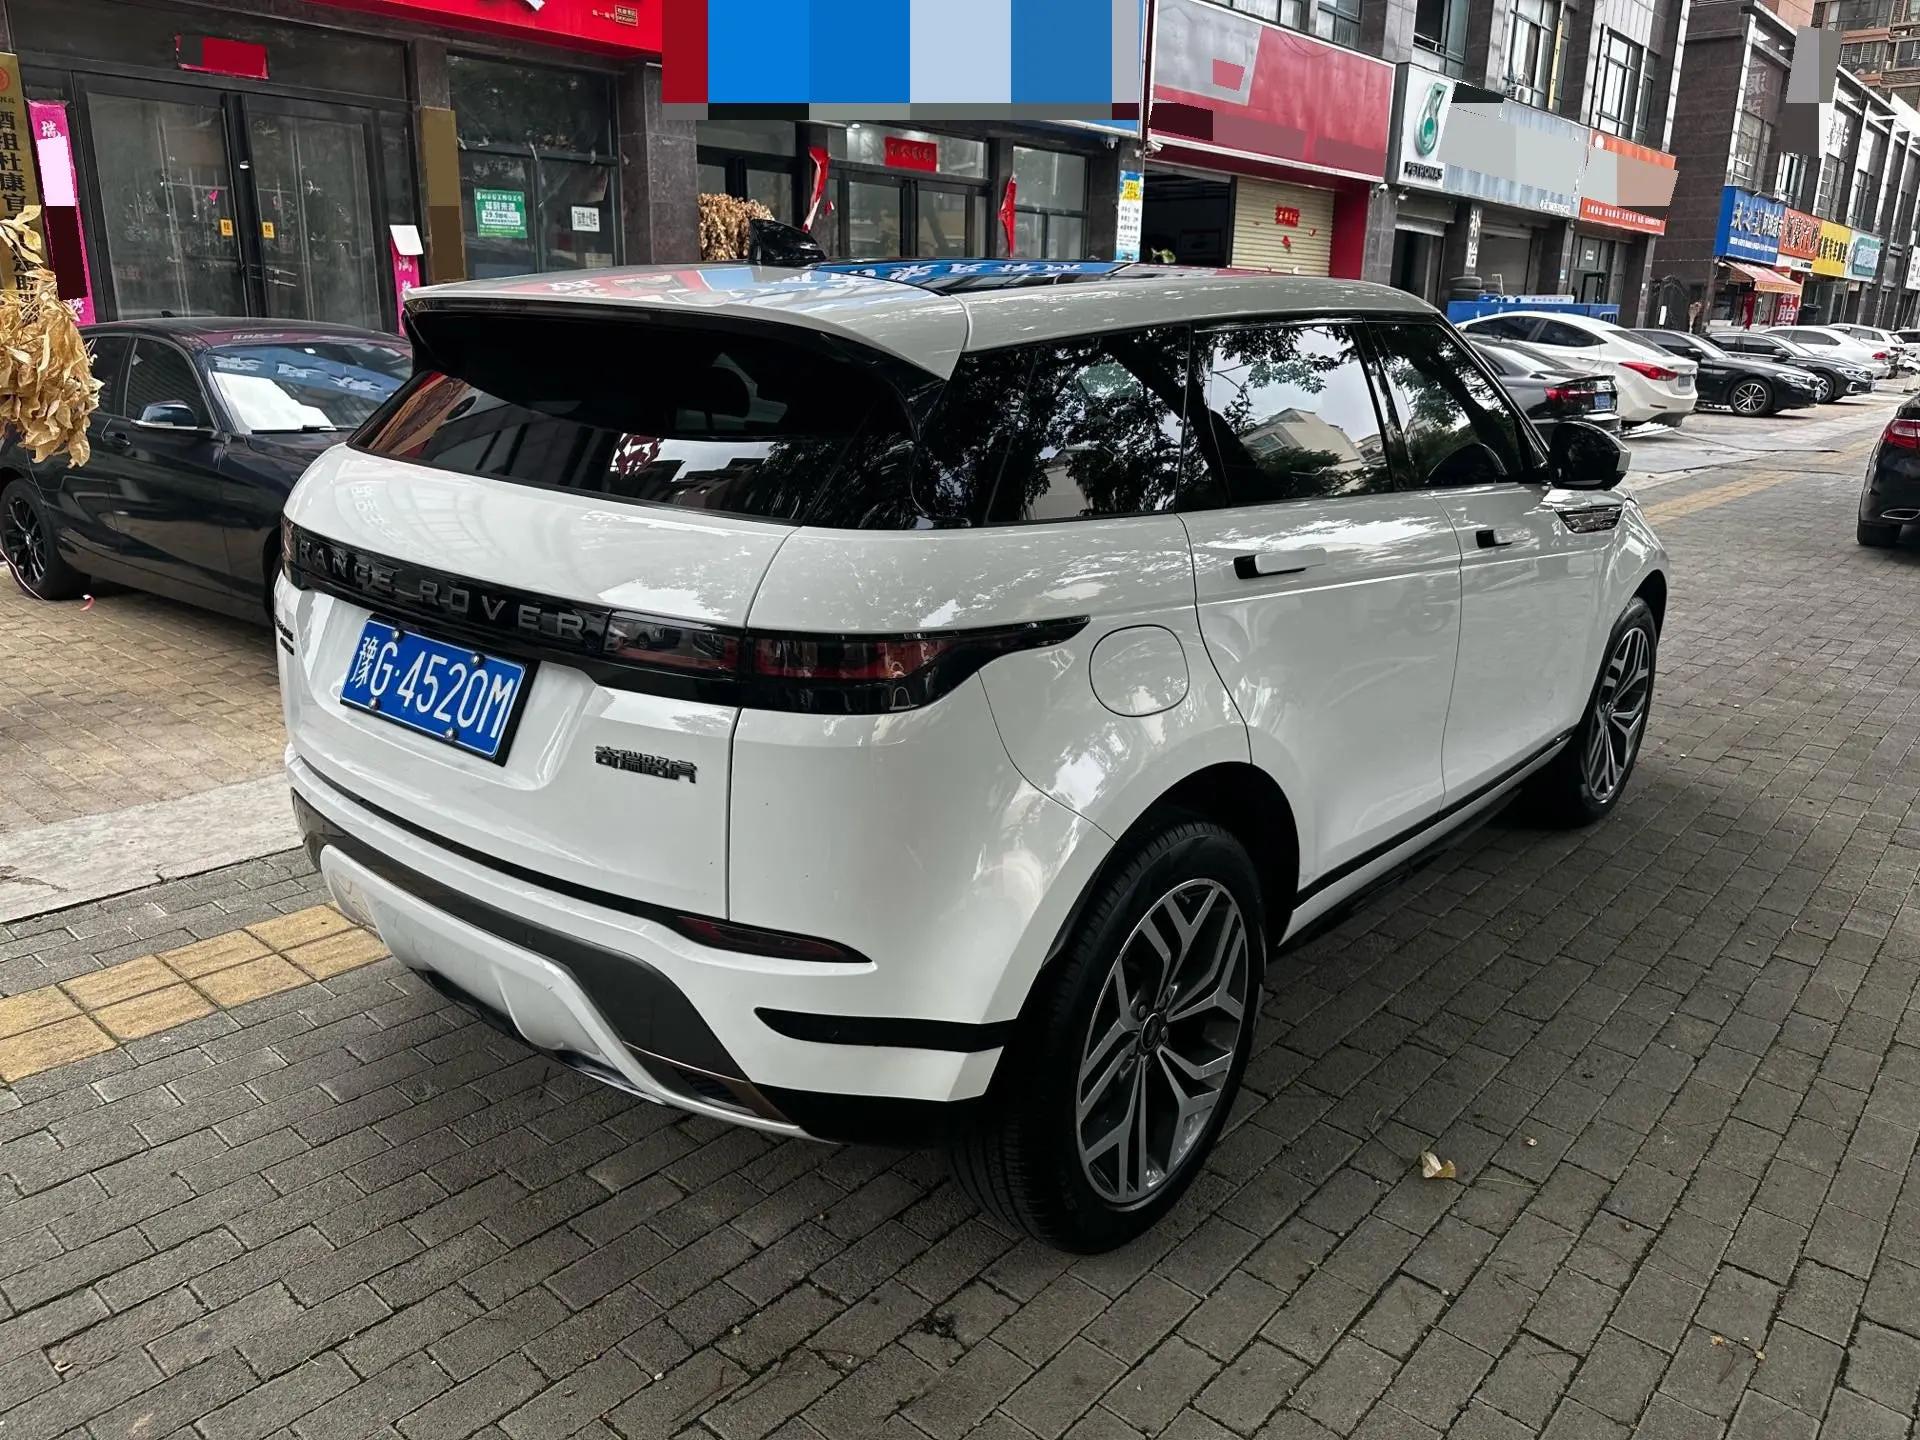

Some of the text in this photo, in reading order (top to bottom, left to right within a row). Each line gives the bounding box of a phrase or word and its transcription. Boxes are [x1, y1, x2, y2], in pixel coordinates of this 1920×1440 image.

[1404, 161, 1444, 181] PETRONAS
[300, 540, 584, 639] RANGE ROVER
[595, 746, 698, 784] 奇瑞路虎
